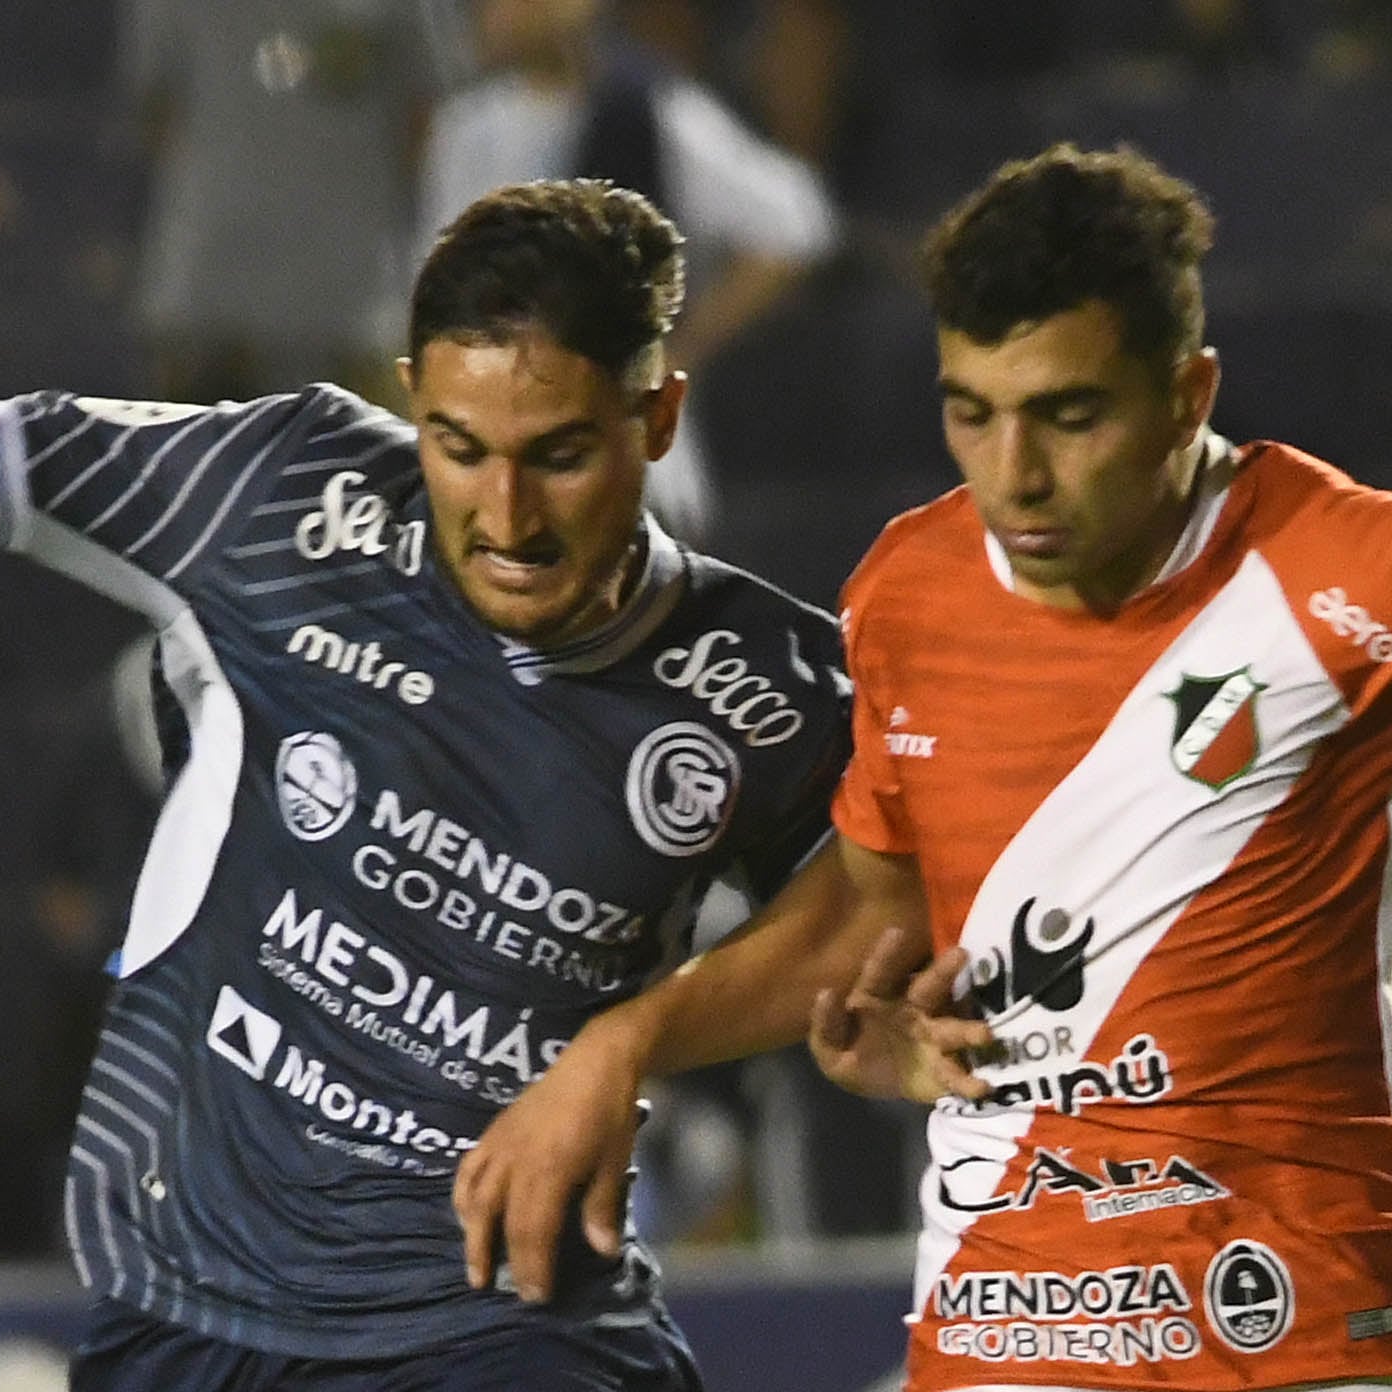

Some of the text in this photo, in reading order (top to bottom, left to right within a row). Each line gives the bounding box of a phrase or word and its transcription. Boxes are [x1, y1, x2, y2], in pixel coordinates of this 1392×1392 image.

[288, 625, 435, 704] mitre
[654, 630, 803, 747] Secco
[346, 1003, 441, 1068] Mutual
[440, 1060, 480, 1091] de
[944, 1034, 1170, 1114] aipú
[1086, 1184, 1218, 1218] Internacio
[938, 1267, 1188, 1317] MENDOZA
[941, 1320, 1200, 1359] GOBIERNO
